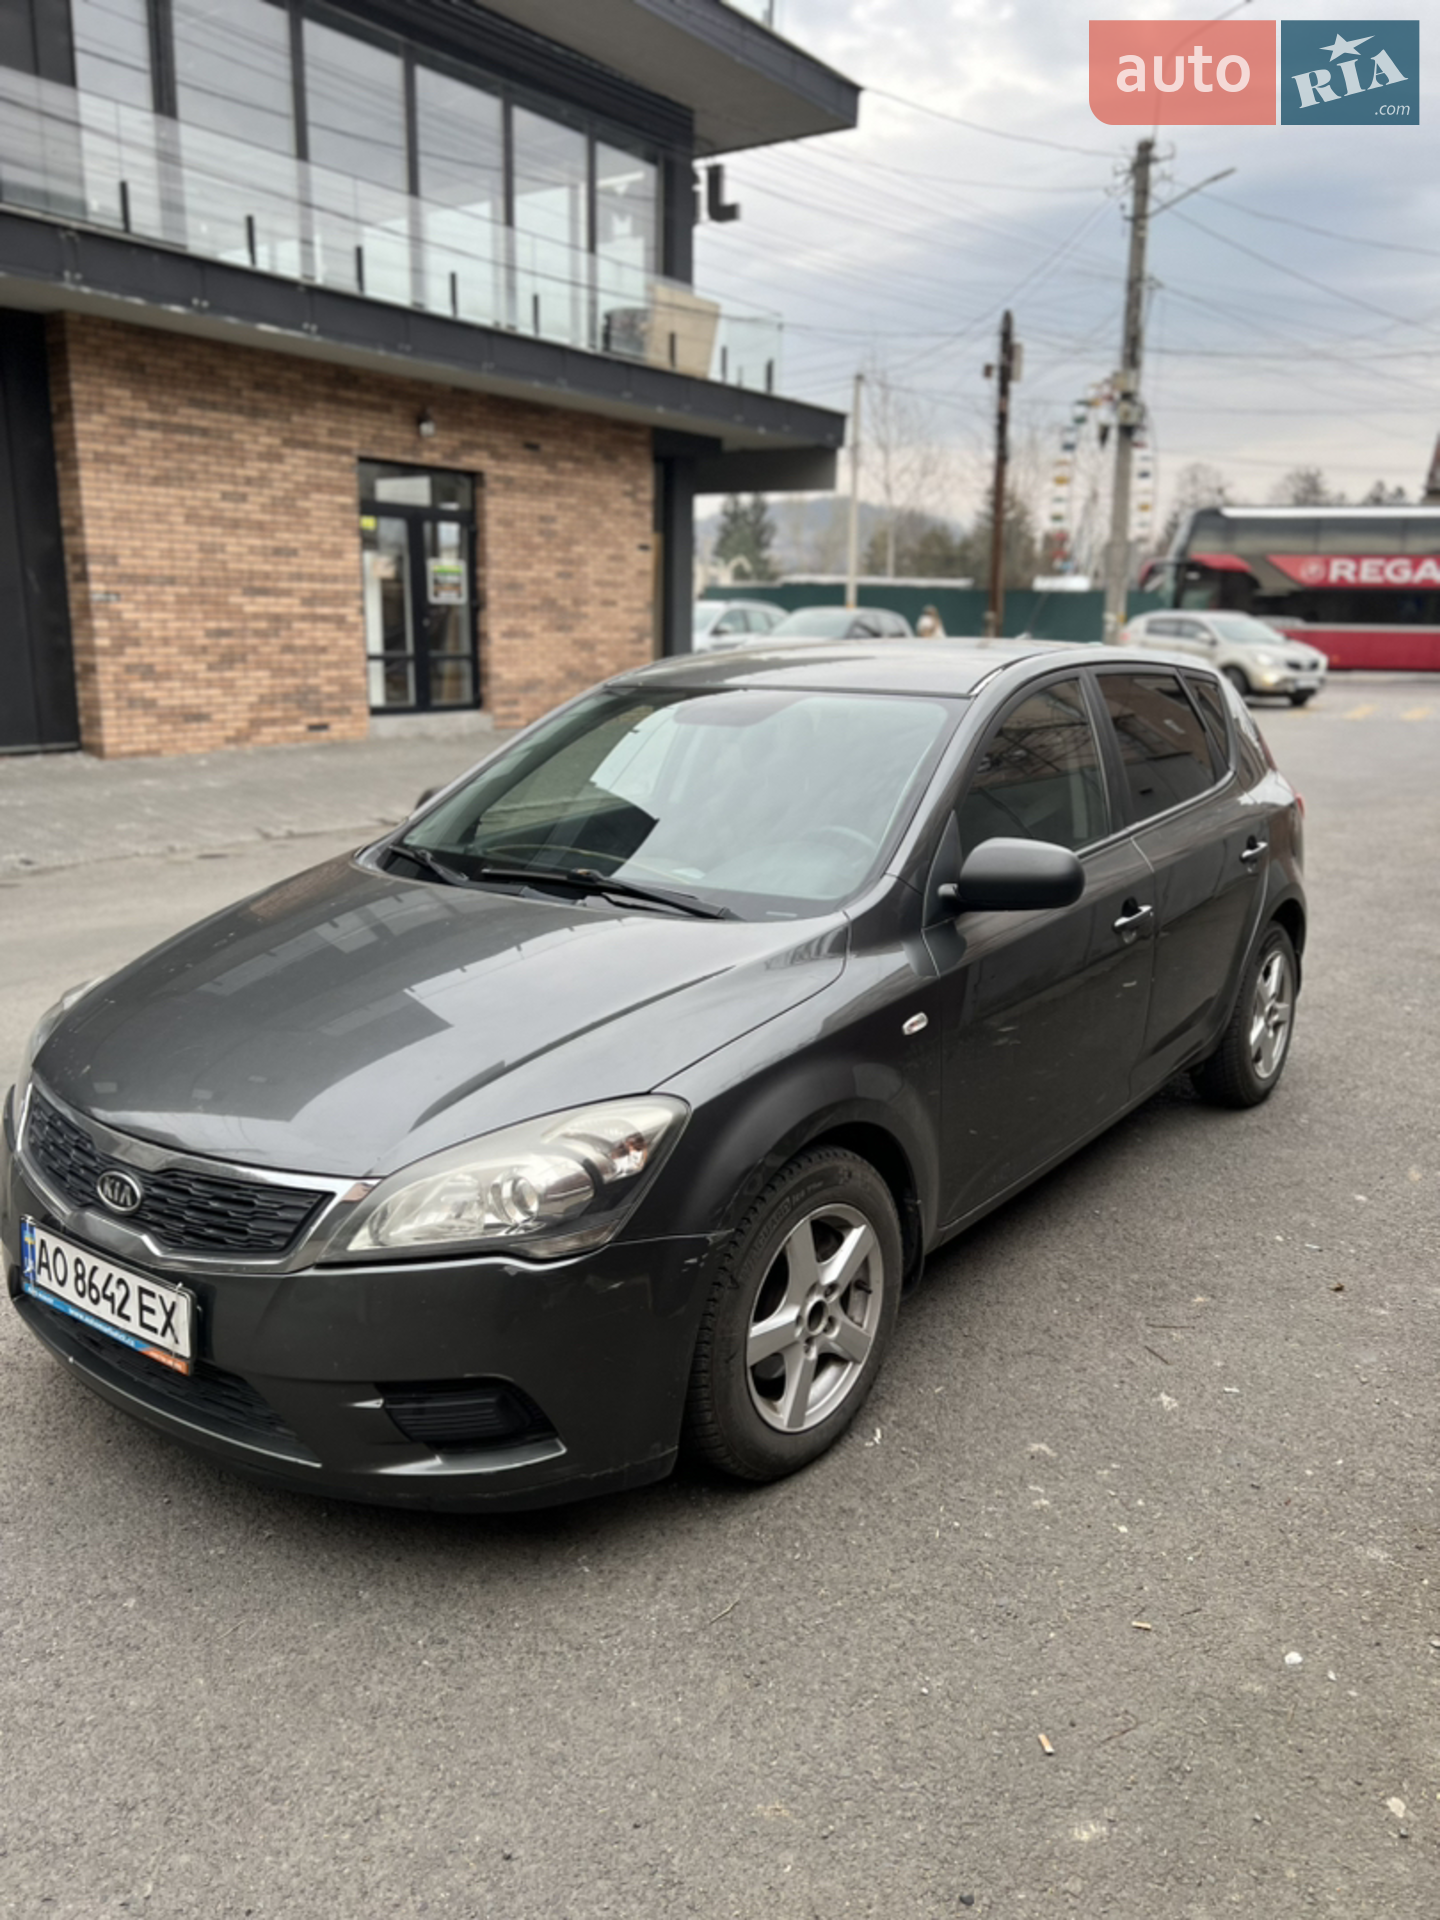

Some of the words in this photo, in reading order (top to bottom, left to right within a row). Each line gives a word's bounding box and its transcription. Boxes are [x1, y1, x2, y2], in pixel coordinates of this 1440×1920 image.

[1329, 558, 1440, 584] REGA
[103, 1176, 132, 1207] KIA
[37, 1238, 68, 1288] AO
[74, 1256, 132, 1323] 8642
[138, 1285, 180, 1345] EX
